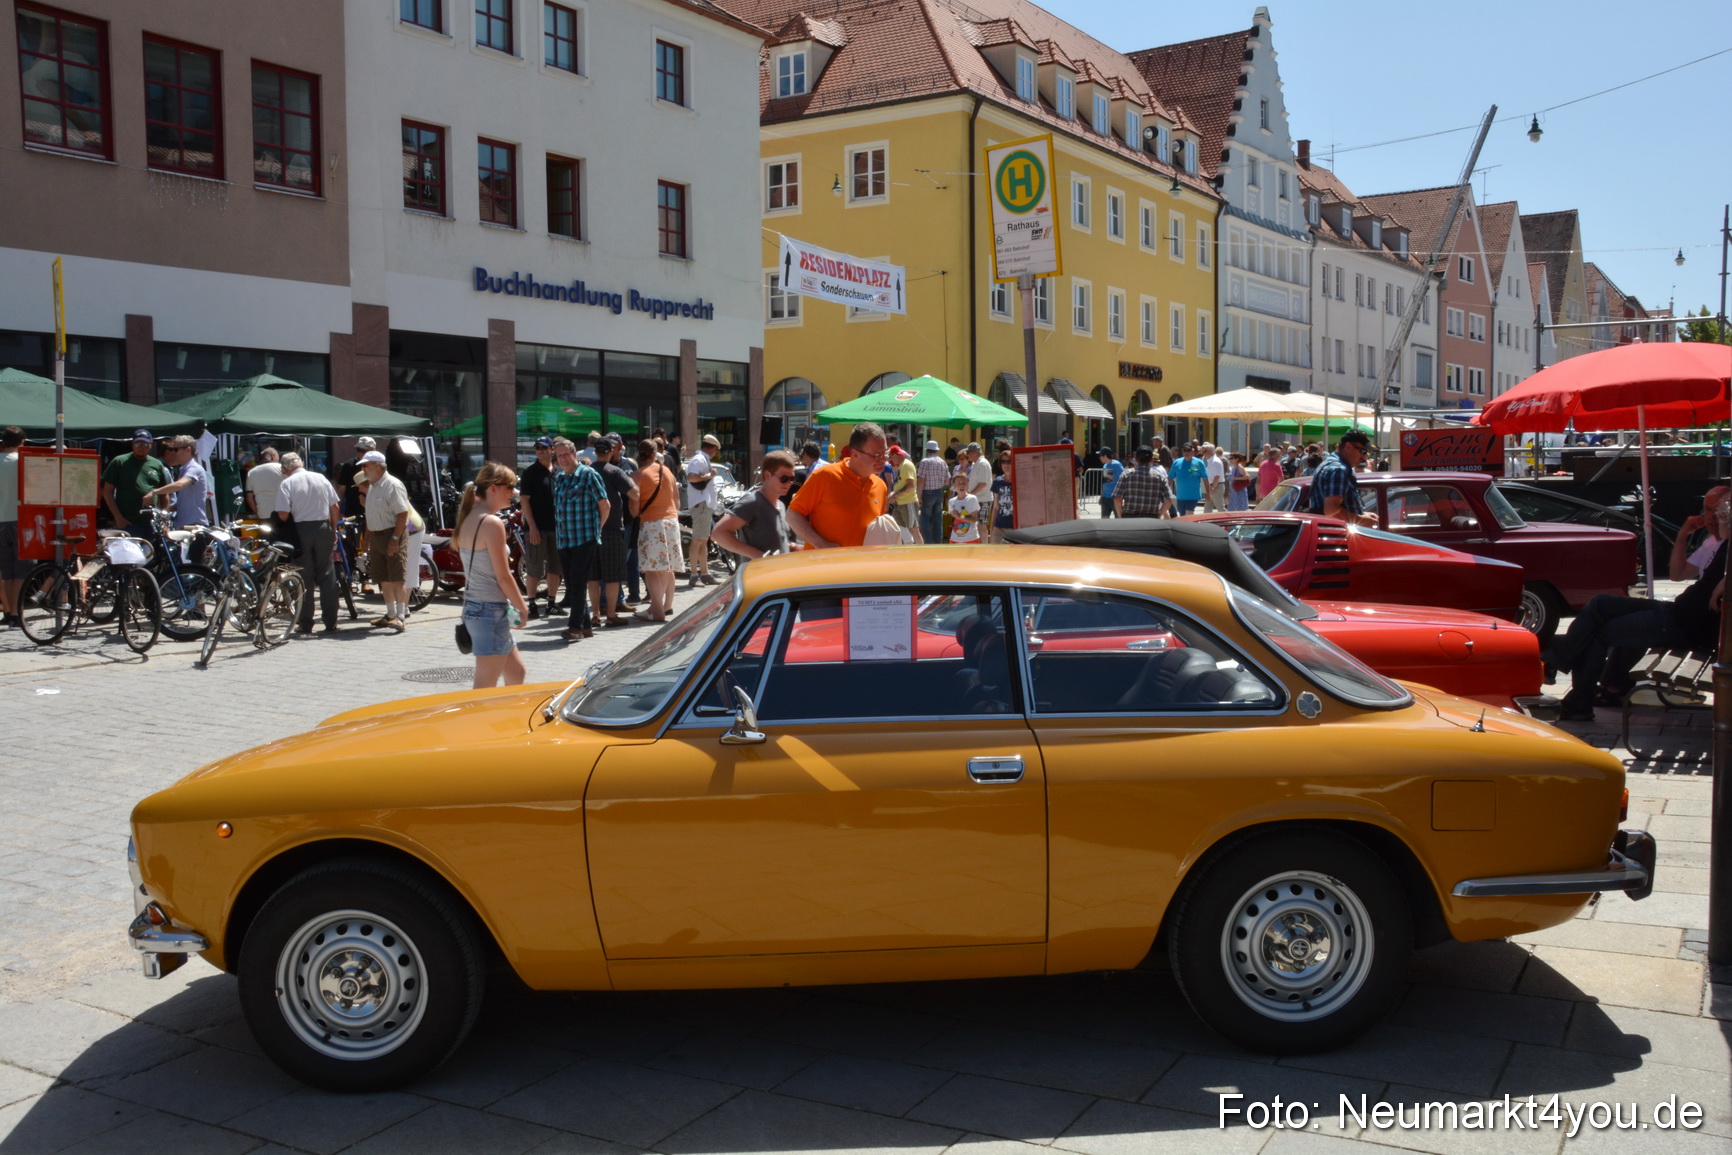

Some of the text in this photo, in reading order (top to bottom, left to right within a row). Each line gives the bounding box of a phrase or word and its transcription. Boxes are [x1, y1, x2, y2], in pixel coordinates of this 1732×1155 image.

[1008, 164, 1032, 200] H
[1007, 221, 1040, 231] Rathaus
[800, 250, 891, 288] RESIDENZPLATZ
[474, 267, 713, 321] Buchhandlung Rupprecht
[820, 281, 875, 302] Sonderschauen
[862, 404, 926, 414] Lammsbräu
